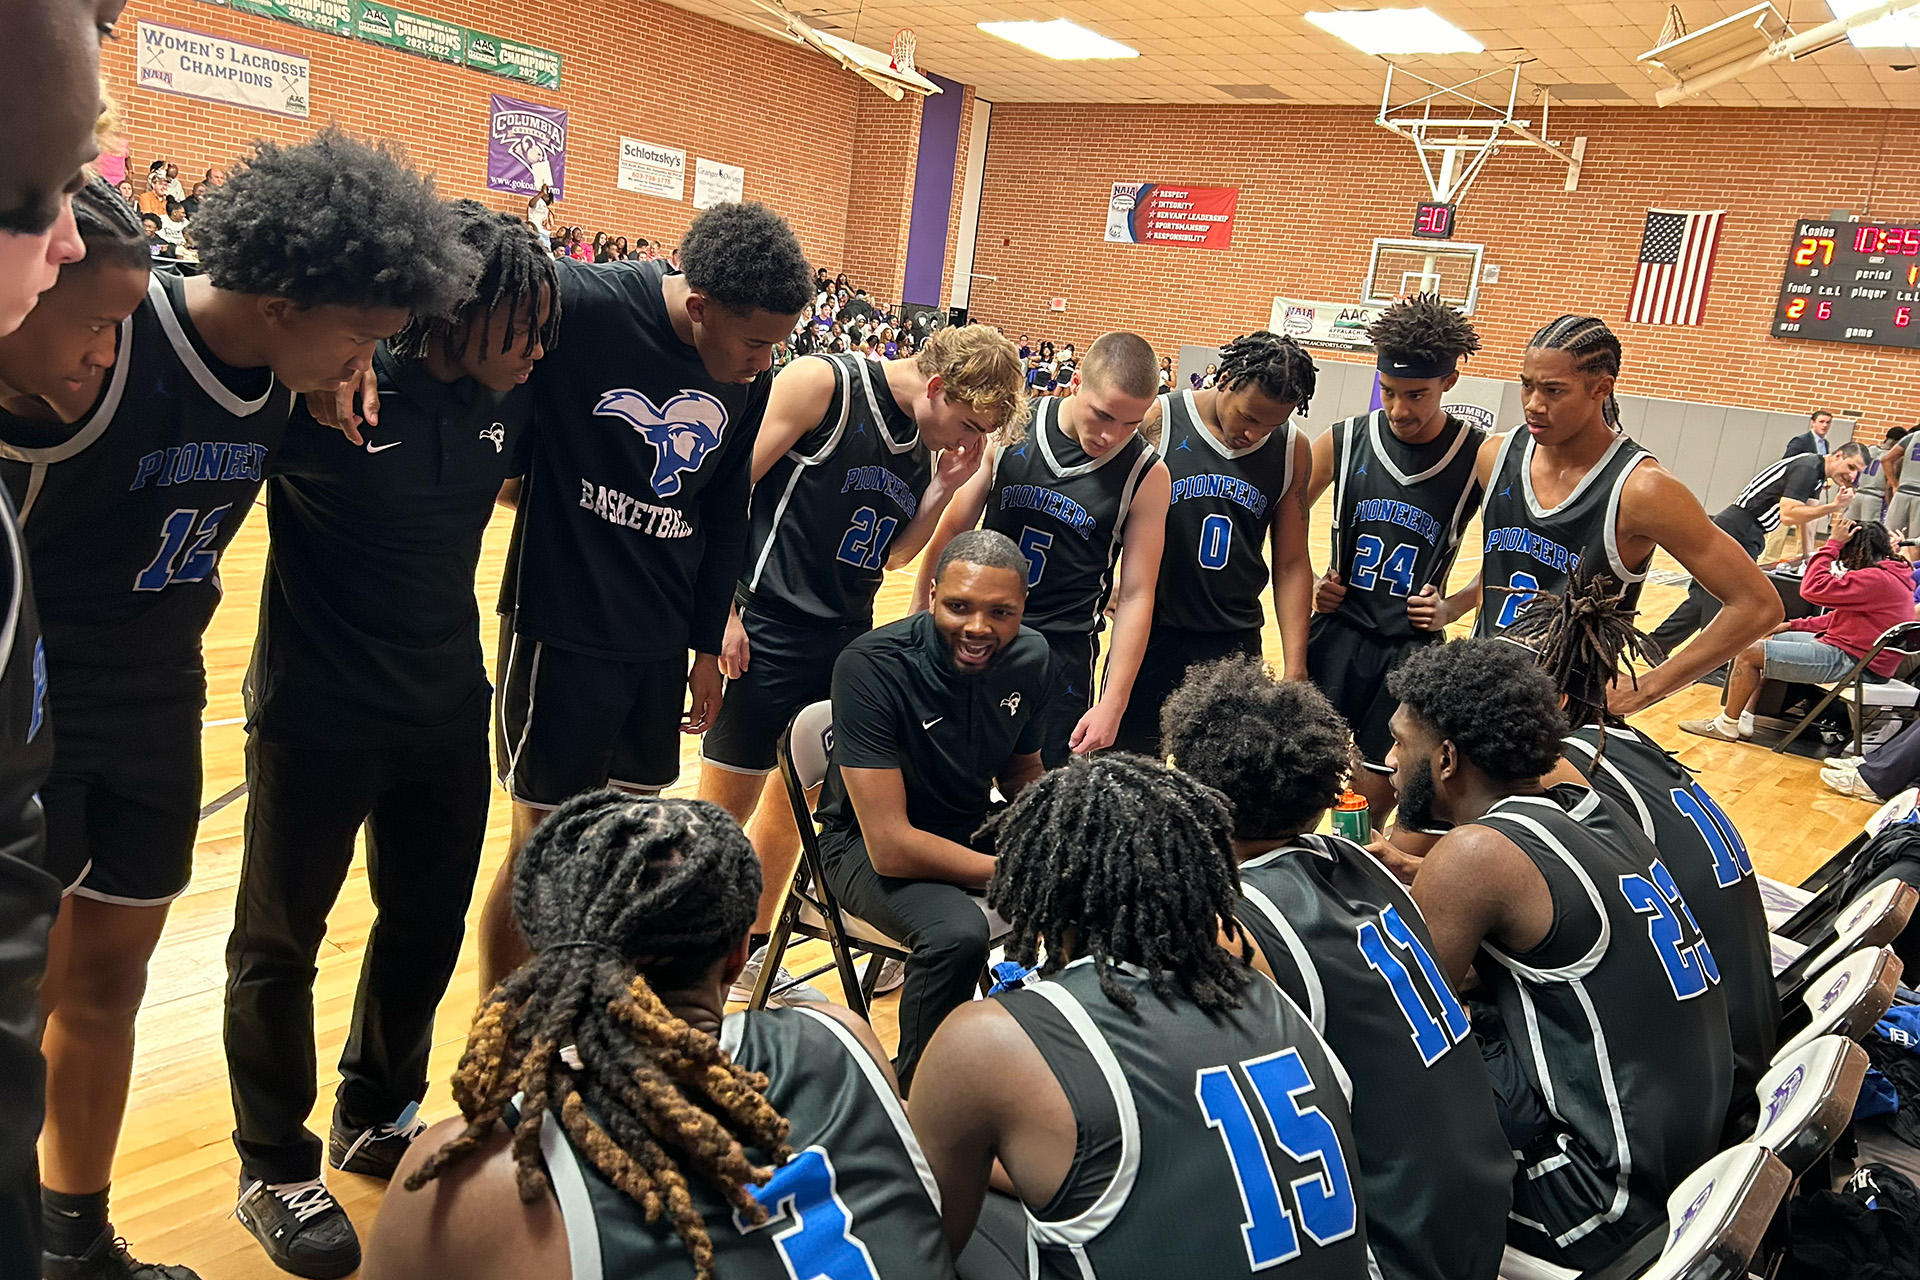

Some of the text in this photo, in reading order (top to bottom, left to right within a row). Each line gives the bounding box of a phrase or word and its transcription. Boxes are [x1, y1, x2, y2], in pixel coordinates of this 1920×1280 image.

[288, 6, 338, 28] 2020-2021
[366, 8, 387, 22] AAC
[394, 20, 461, 51] CHAMPIONS
[405, 36, 450, 56] 2021-2022
[142, 28, 307, 78] WOMEN'S LACROSSE
[499, 49, 559, 77] CHAMPIONS
[142, 69, 172, 84] NAIA
[180, 56, 273, 89] CHAMPIONS
[519, 66, 539, 79] 2022
[496, 114, 561, 145] COLUMBIA
[513, 127, 546, 139] COLLEGE
[624, 144, 681, 167] Schlotzsky's
[1113, 186, 1136, 196] NAIA
[1160, 190, 1188, 199] RESPECT
[1158, 201, 1194, 210] INTEGRITY
[1155, 221, 1210, 232] SPORTSMANSHIP
[1156, 211, 1229, 222] SERVANT LEADERSHIP
[1418, 206, 1448, 233] 30
[1153, 231, 1207, 242] RESPONSIBILITY
[1800, 224, 1835, 238] Koalas
[1854, 227, 1920, 256] 10:35
[1795, 239, 1835, 266] 27
[1855, 269, 1893, 281] period
[1787, 283, 1812, 294] fouls
[1851, 286, 1887, 299] player
[1286, 306, 1314, 320] NAIA
[1340, 308, 1370, 322] AAC
[1787, 297, 1807, 320] 2
[1816, 301, 1832, 320] 6
[1895, 306, 1911, 327] 6
[1780, 322, 1800, 332] won
[1845, 327, 1874, 338] game
[841, 465, 917, 519] PIONEERS
[1171, 474, 1268, 519] PIONEERS
[1000, 484, 1096, 540] PIONEERS
[836, 506, 898, 571] 21
[1198, 513, 1235, 571] 0
[1020, 525, 1054, 588] 5
[1349, 533, 1419, 598] 24
[1495, 570, 1540, 629] 2
[1356, 902, 1472, 1068] 11
[1196, 1046, 1357, 1273] 15
